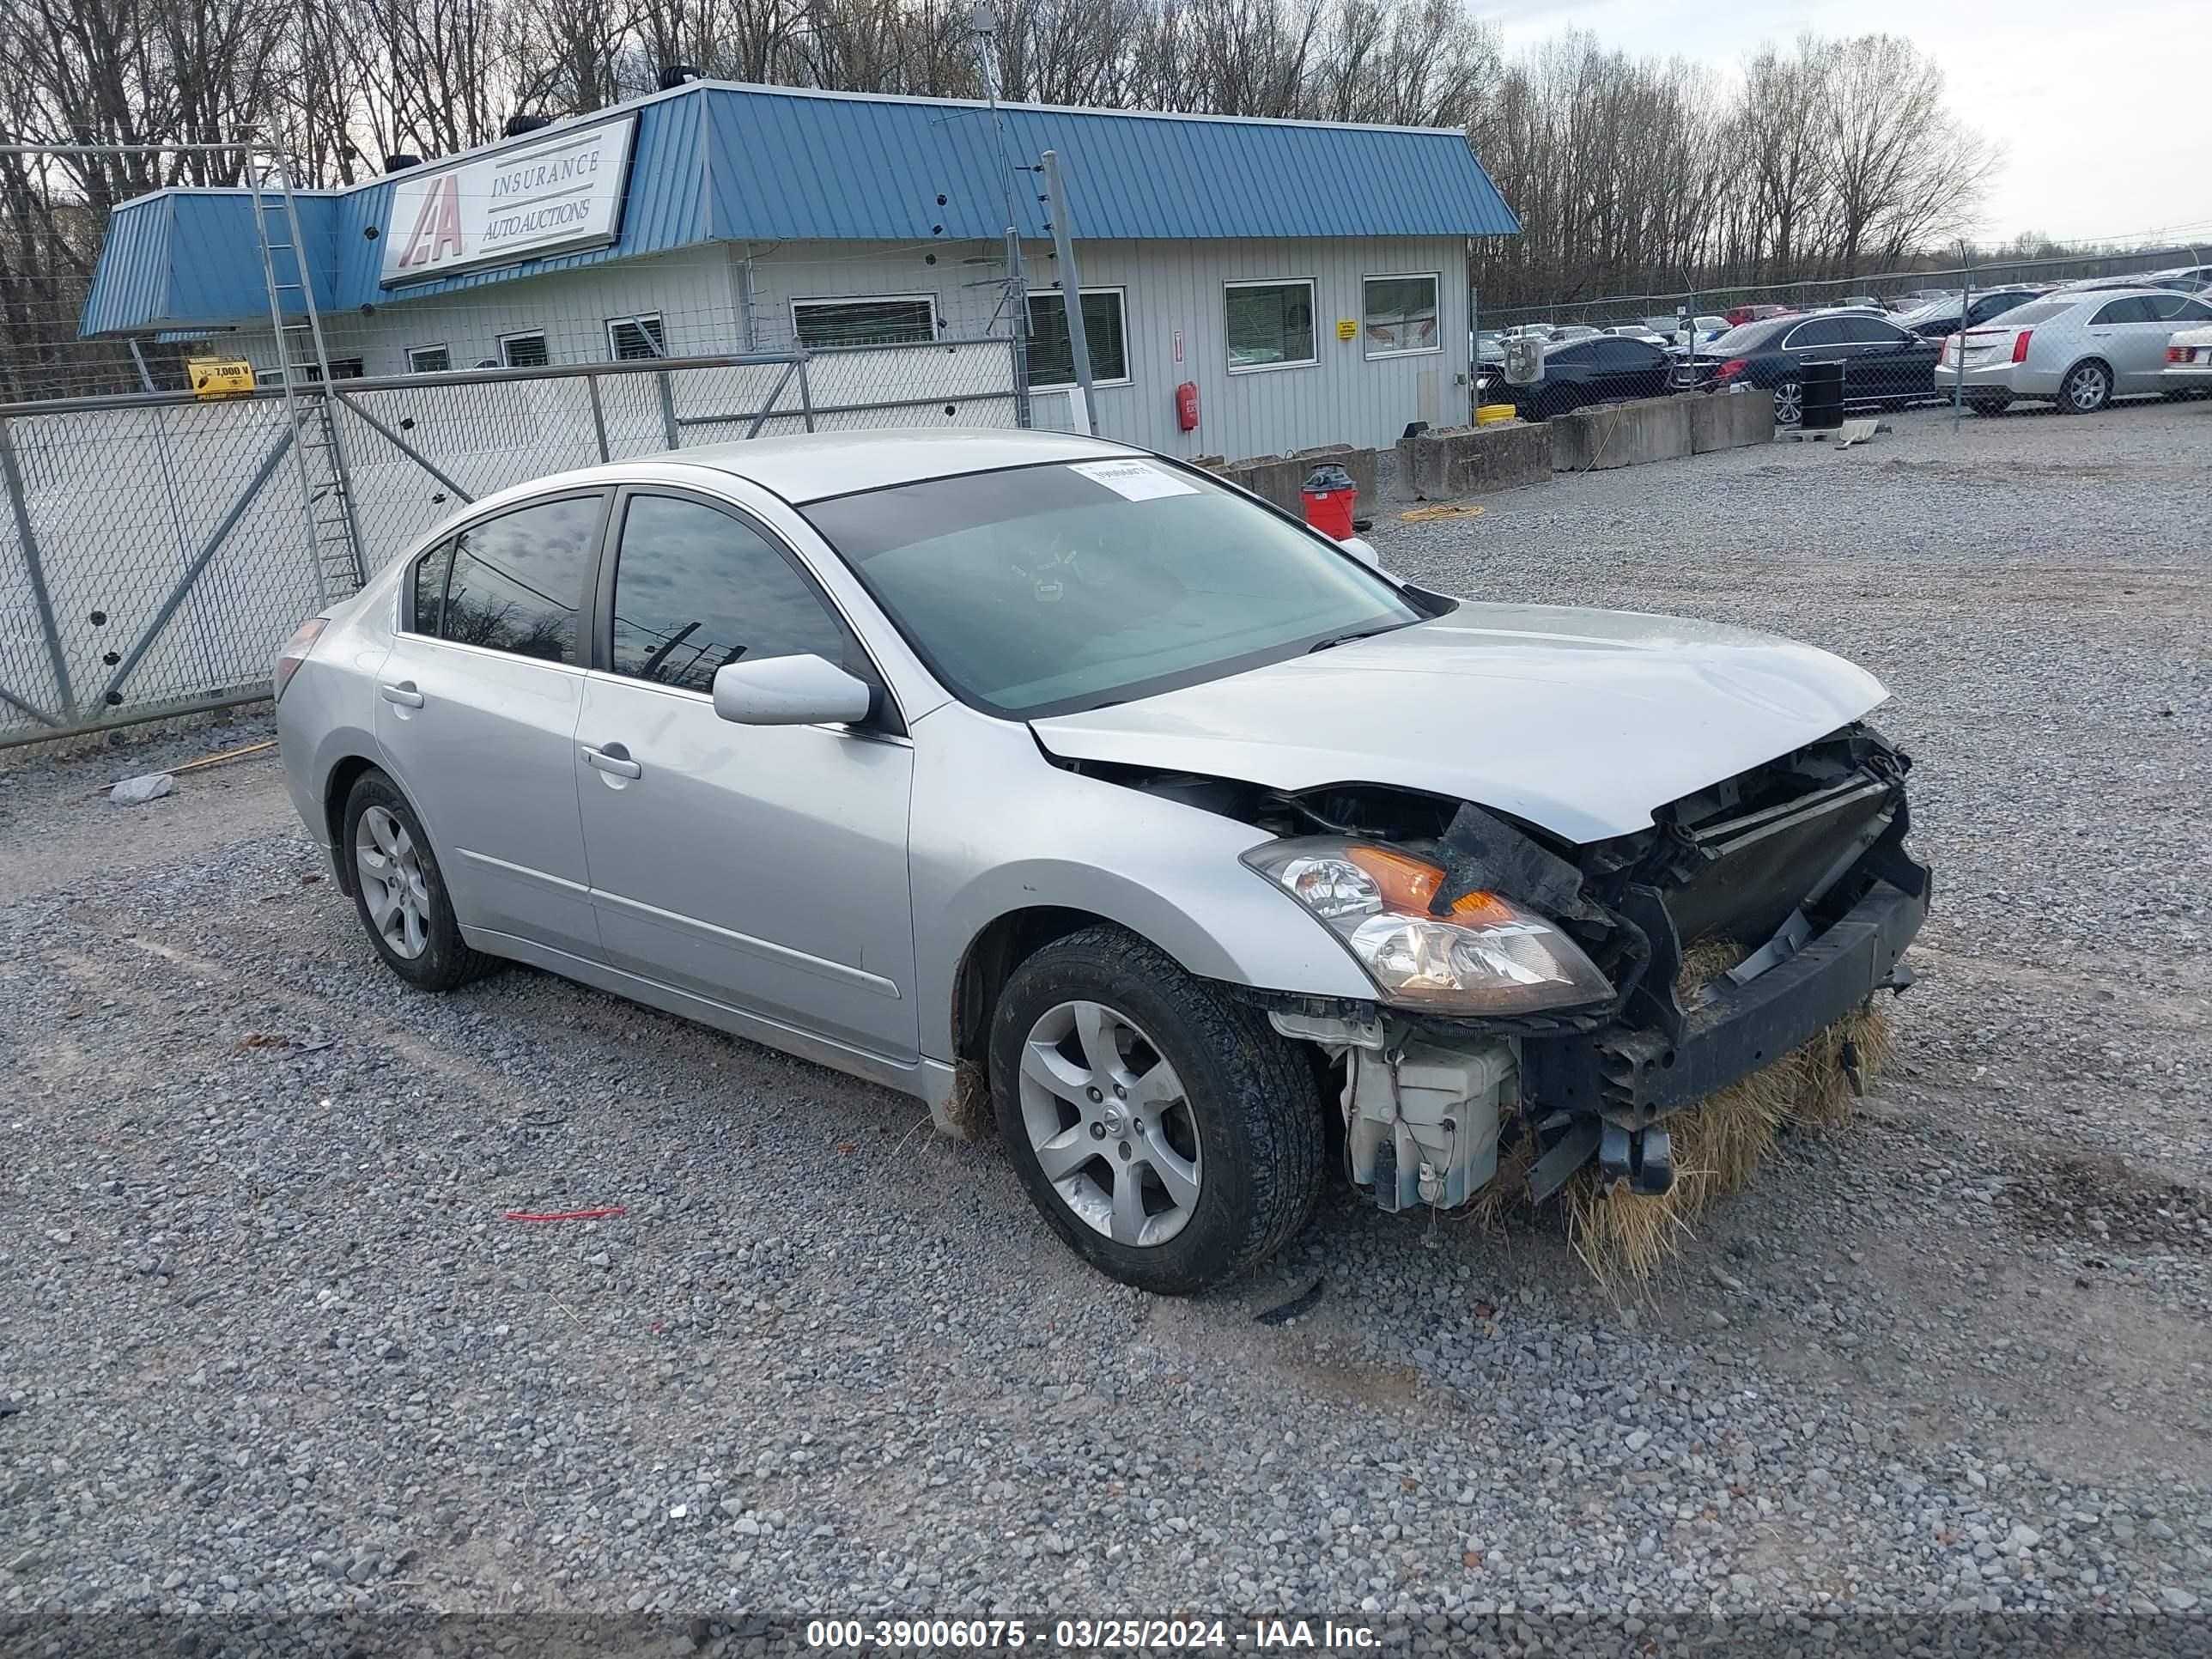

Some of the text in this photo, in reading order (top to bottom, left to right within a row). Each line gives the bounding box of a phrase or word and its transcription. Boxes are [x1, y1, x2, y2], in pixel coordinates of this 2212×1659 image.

[490, 150, 599, 198] INSURANCE
[214, 366, 249, 378] 7,000 V
